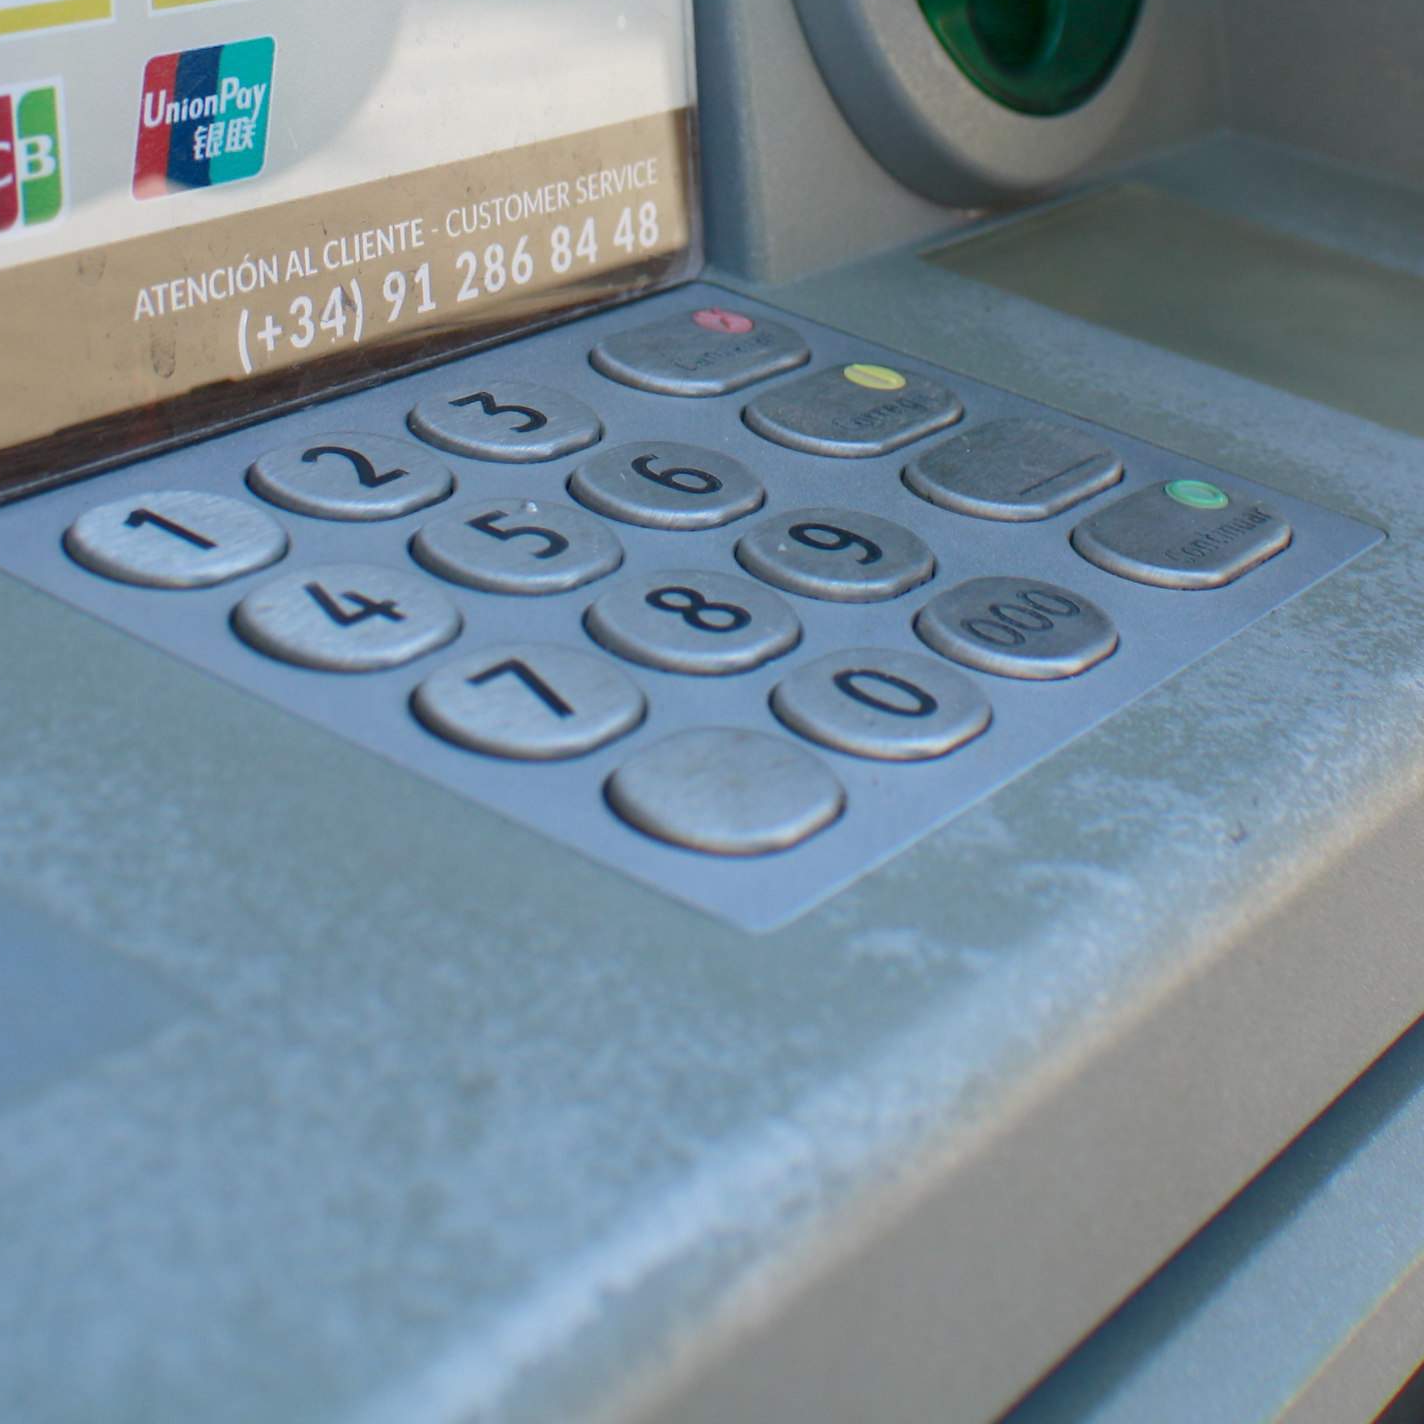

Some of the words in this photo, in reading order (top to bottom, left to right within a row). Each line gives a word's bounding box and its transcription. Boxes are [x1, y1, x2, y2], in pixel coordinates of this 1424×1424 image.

[142, 76, 268, 128] UnionPay
[193, 116, 257, 161] 银联
[134, 253, 280, 322] ATENCIÓN
[284, 245, 319, 283] AL
[322, 217, 425, 271] CLIENTE
[445, 181, 572, 239] CUSTOMER
[576, 158, 659, 205] SERVICE
[237, 278, 364, 375] (+34)
[382, 262, 438, 323] 91
[455, 235, 535, 303] 286
[550, 216, 599, 274] 84
[613, 201, 660, 254] 48
[447, 390, 548, 433] 3
[301, 445, 409, 489] 2
[631, 453, 724, 494] 6
[122, 508, 219, 551] 1
[464, 509, 570, 560] 5
[788, 522, 883, 566] 9
[303, 581, 407, 627] 4
[645, 585, 753, 634] 8
[465, 657, 574, 718] 7
[832, 668, 939, 718] 0
